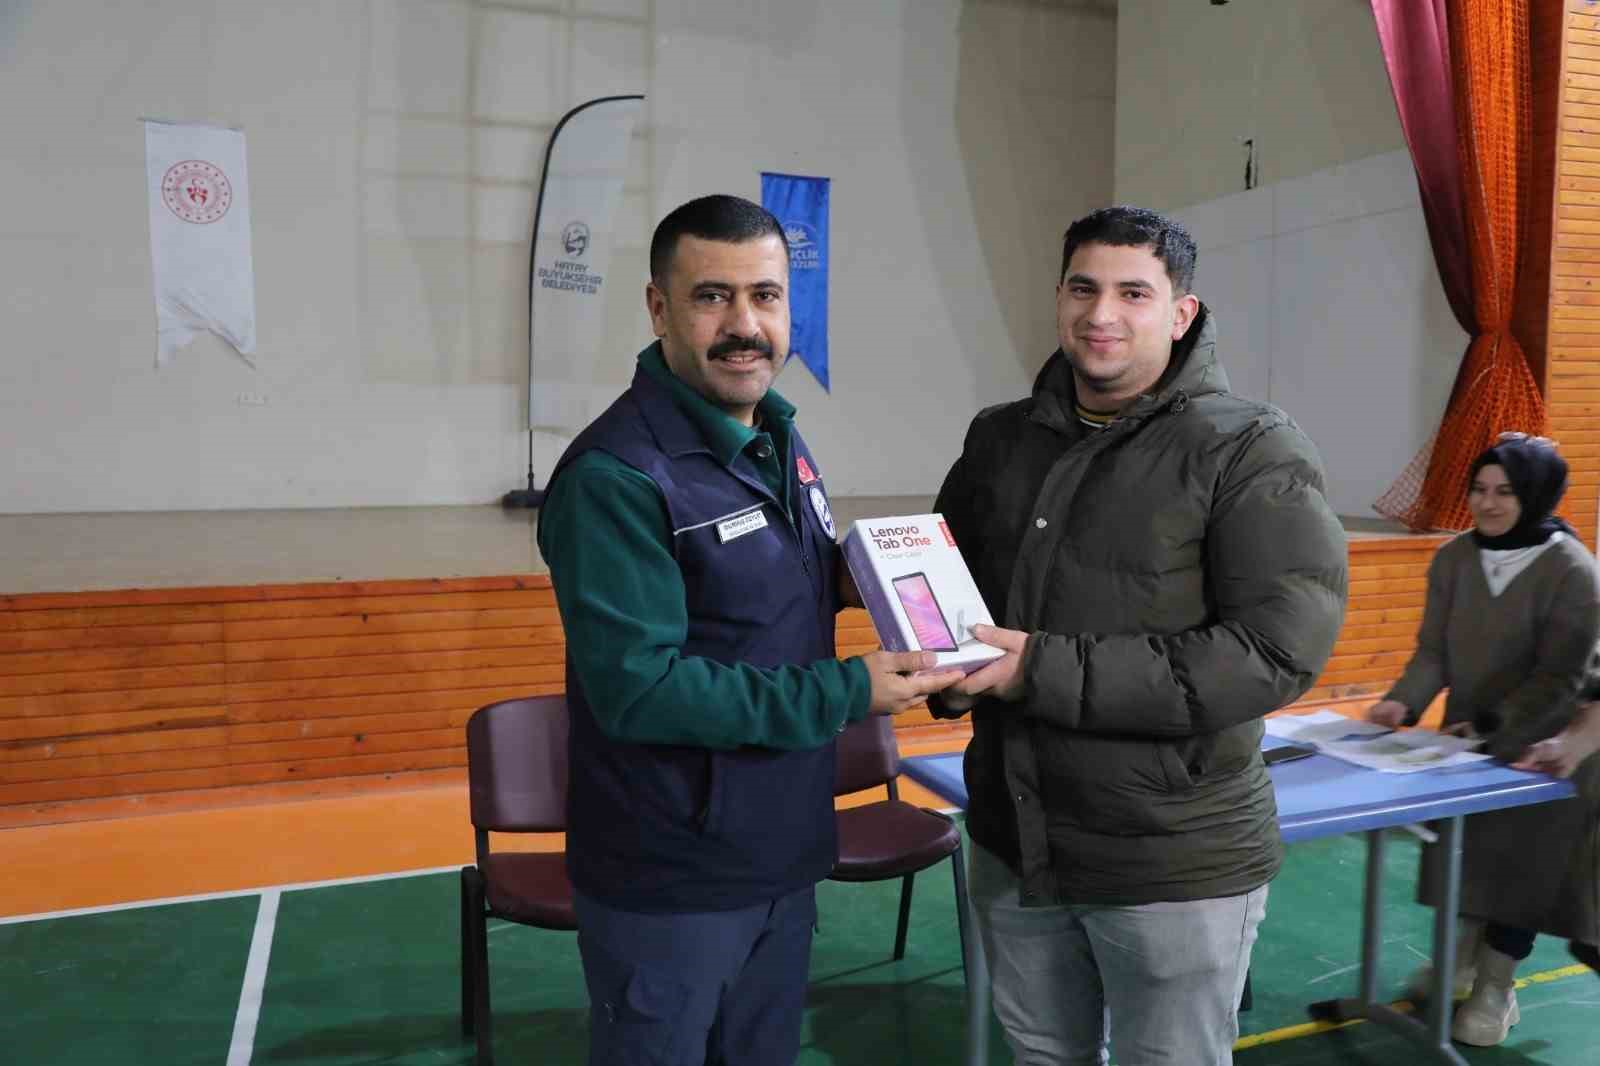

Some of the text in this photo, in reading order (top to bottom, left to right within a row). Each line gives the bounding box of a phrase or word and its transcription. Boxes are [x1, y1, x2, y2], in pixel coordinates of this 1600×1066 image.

[554, 261, 590, 273] HATAY
[868, 526, 920, 537] Lenovo
[873, 537, 932, 550] Tab One
